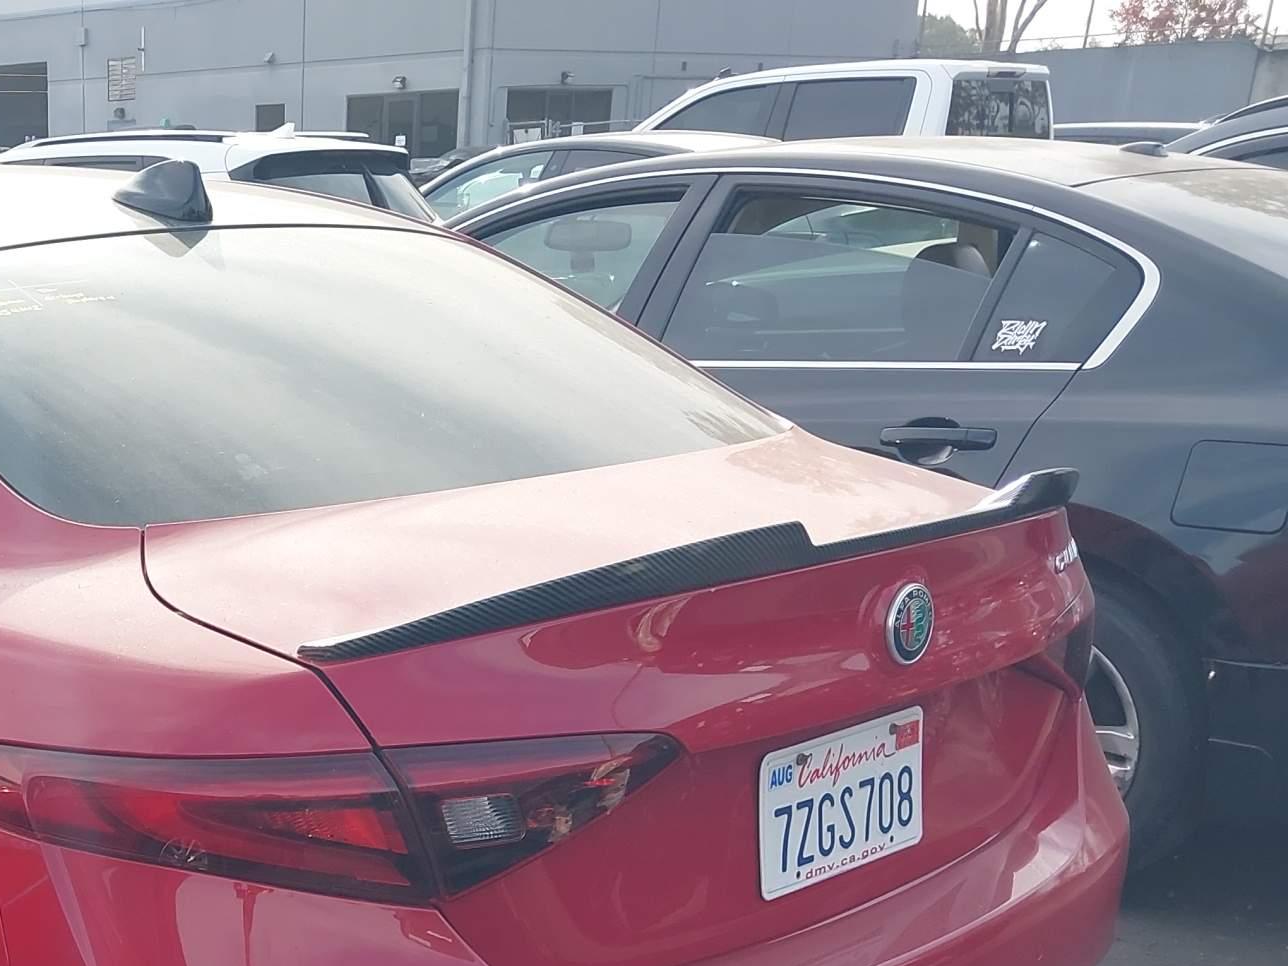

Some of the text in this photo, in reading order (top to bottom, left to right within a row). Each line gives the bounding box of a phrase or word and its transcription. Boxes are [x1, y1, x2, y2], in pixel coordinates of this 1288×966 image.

[894, 596, 911, 628] ALFA
[770, 763, 793, 790] AUG
[798, 743, 896, 788] California
[774, 765, 914, 873] 7ZGS708
[805, 842, 886, 880] dmv.ca.gov
